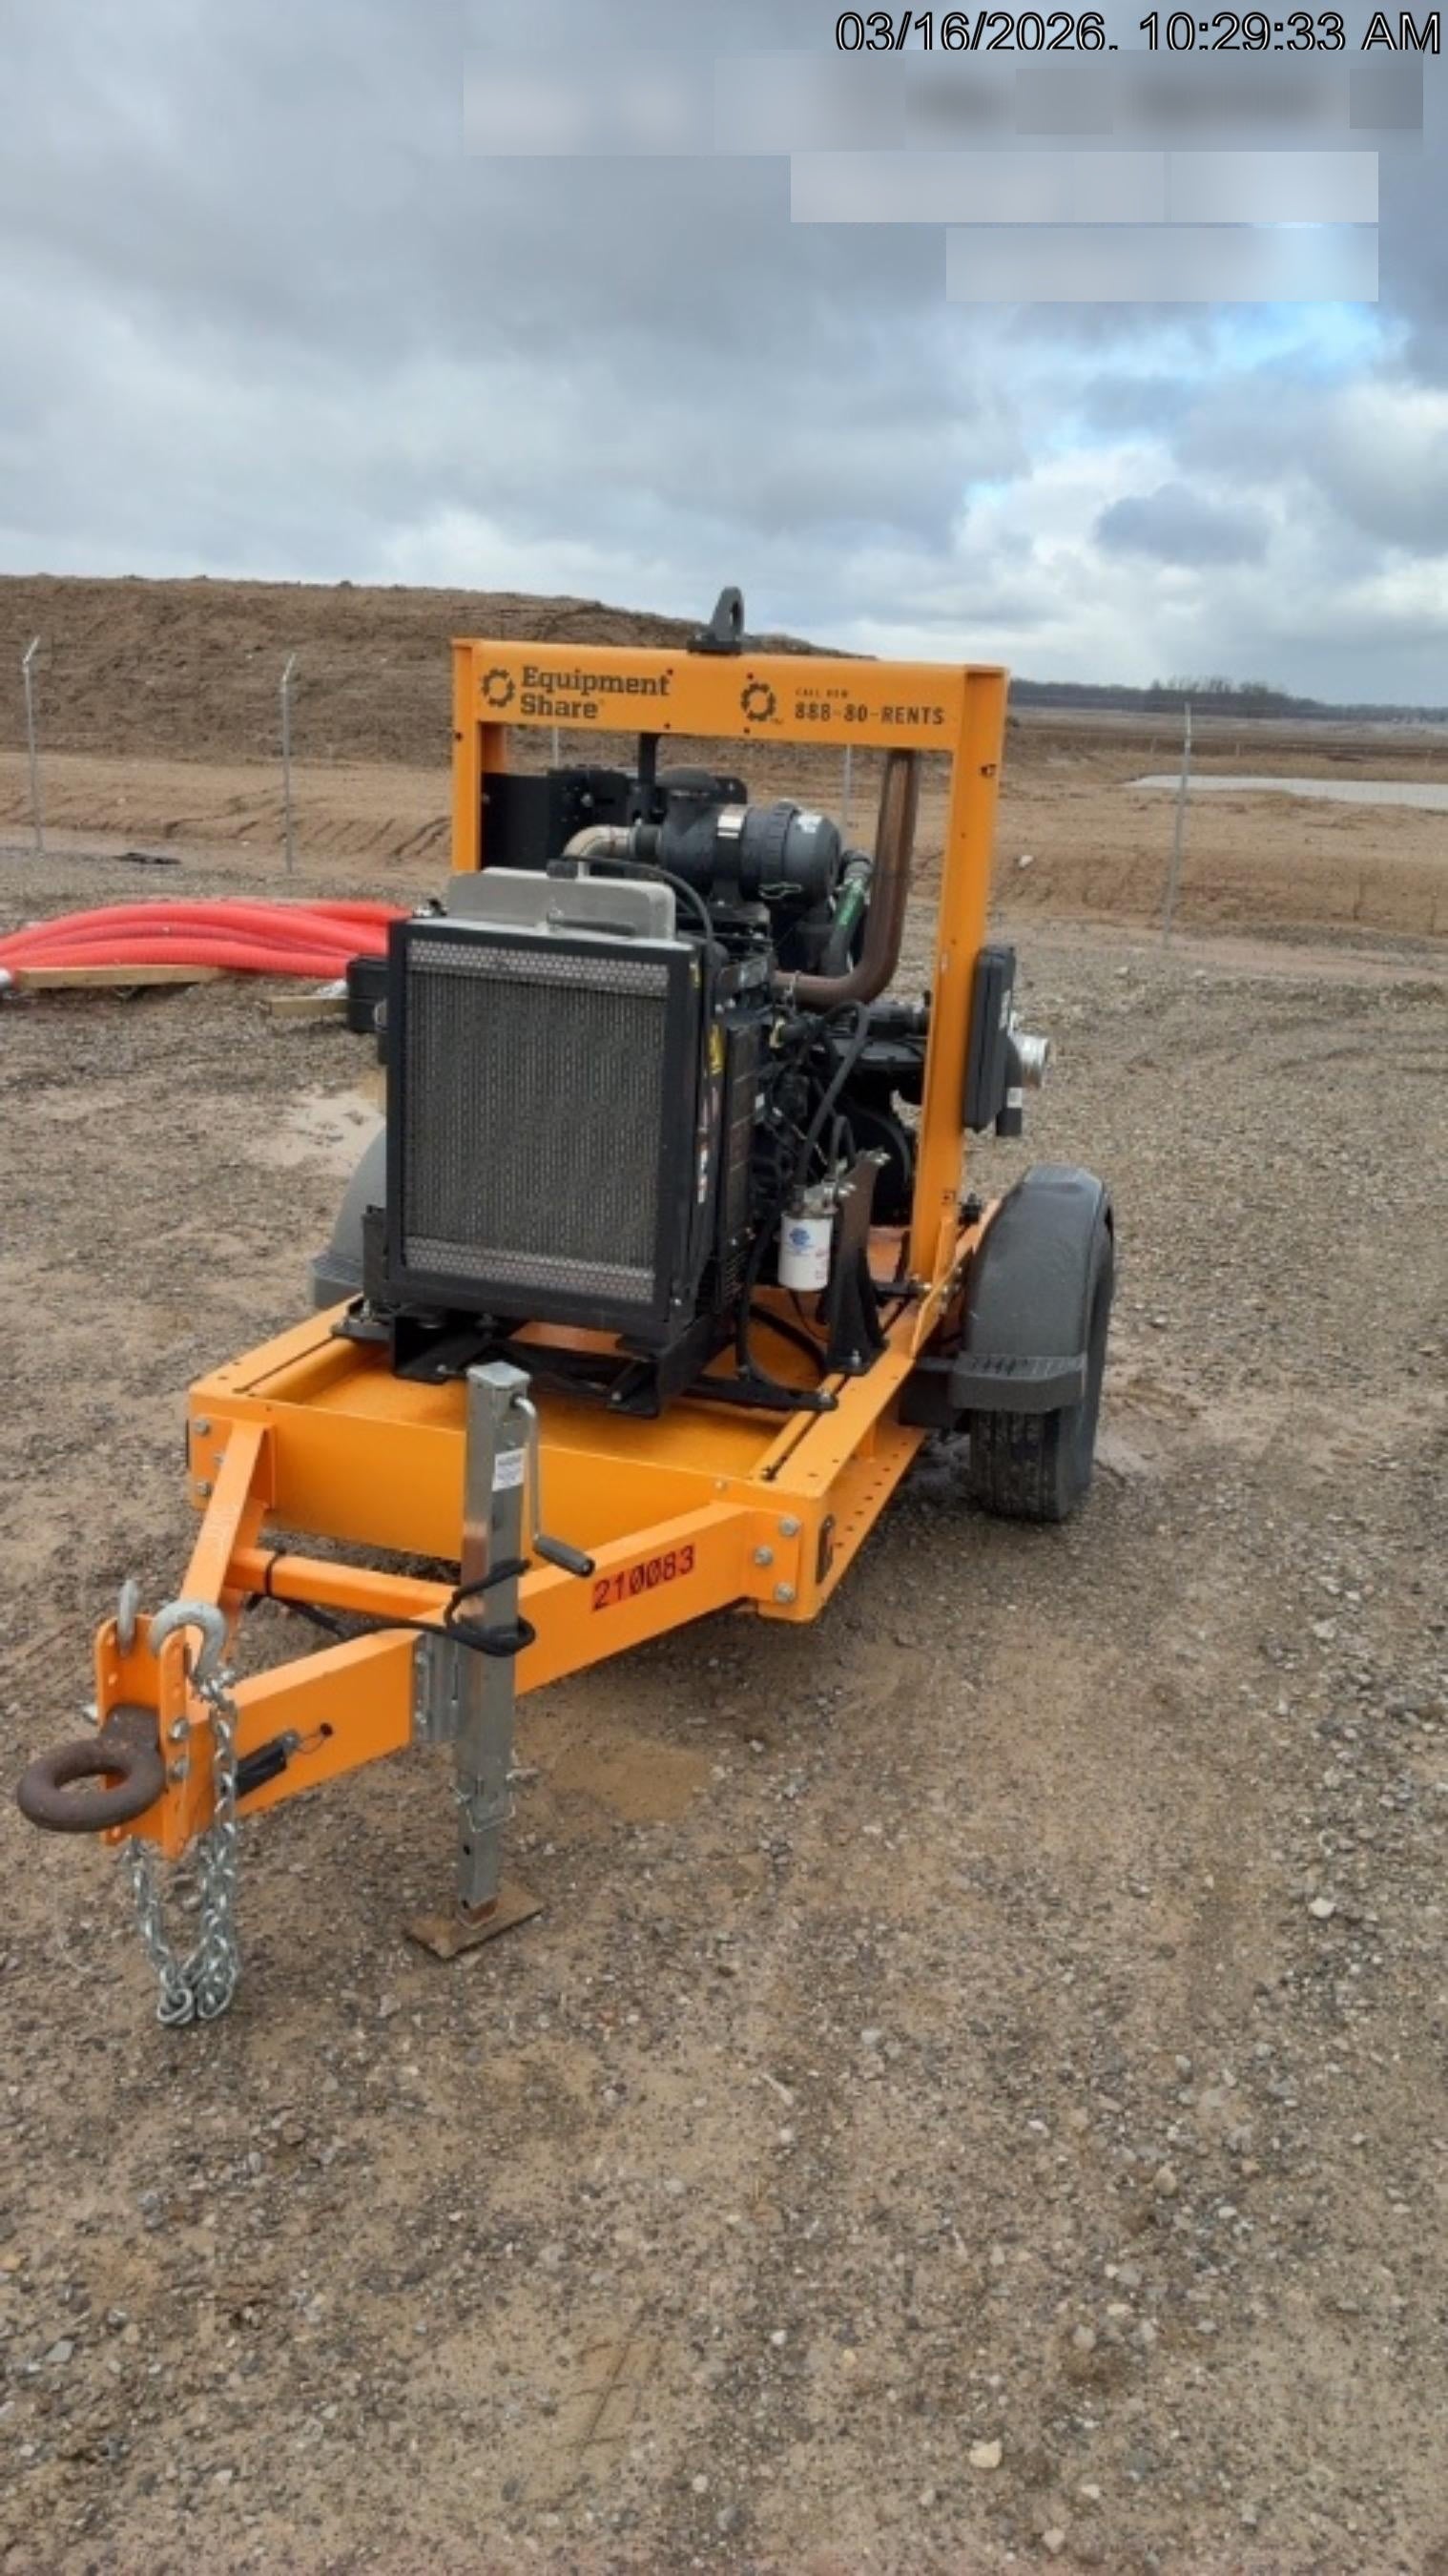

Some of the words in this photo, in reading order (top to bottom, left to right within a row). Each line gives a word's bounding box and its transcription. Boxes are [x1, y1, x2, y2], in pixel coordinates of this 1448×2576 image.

[522, 665, 671, 696] Equipment
[520, 692, 599, 719] Share
[795, 702, 945, 726] 888-80-RENTS
[591, 1544, 695, 1612] 210083
